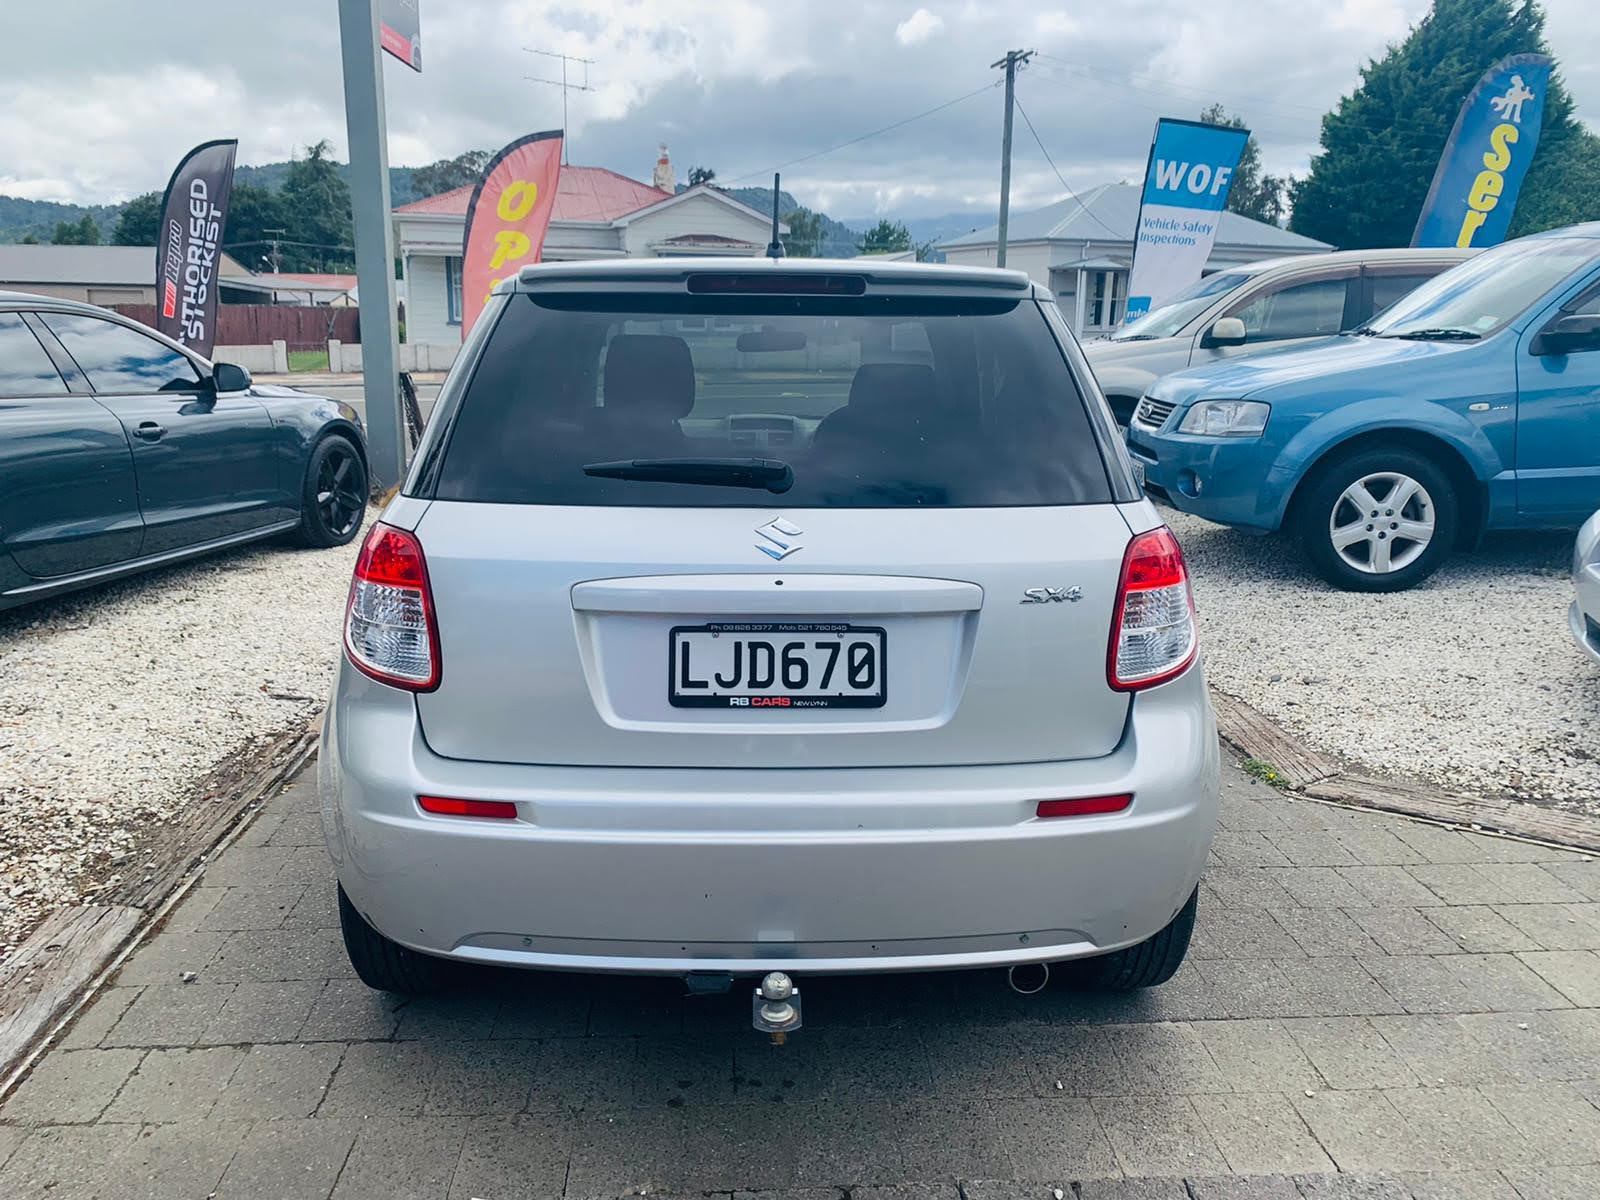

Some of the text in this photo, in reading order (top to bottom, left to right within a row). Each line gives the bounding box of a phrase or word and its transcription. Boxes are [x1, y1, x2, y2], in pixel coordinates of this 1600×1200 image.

[1155, 159, 1232, 196] WOF
[1143, 217, 1213, 236] Vehicle Safety
[1140, 231, 1196, 246] Inspections
[188, 203, 222, 341] STOCKIST
[1020, 585, 1083, 604] SX4
[681, 641, 875, 689] LJD670
[729, 697, 749, 706] RB
[751, 697, 791, 706] CARS
